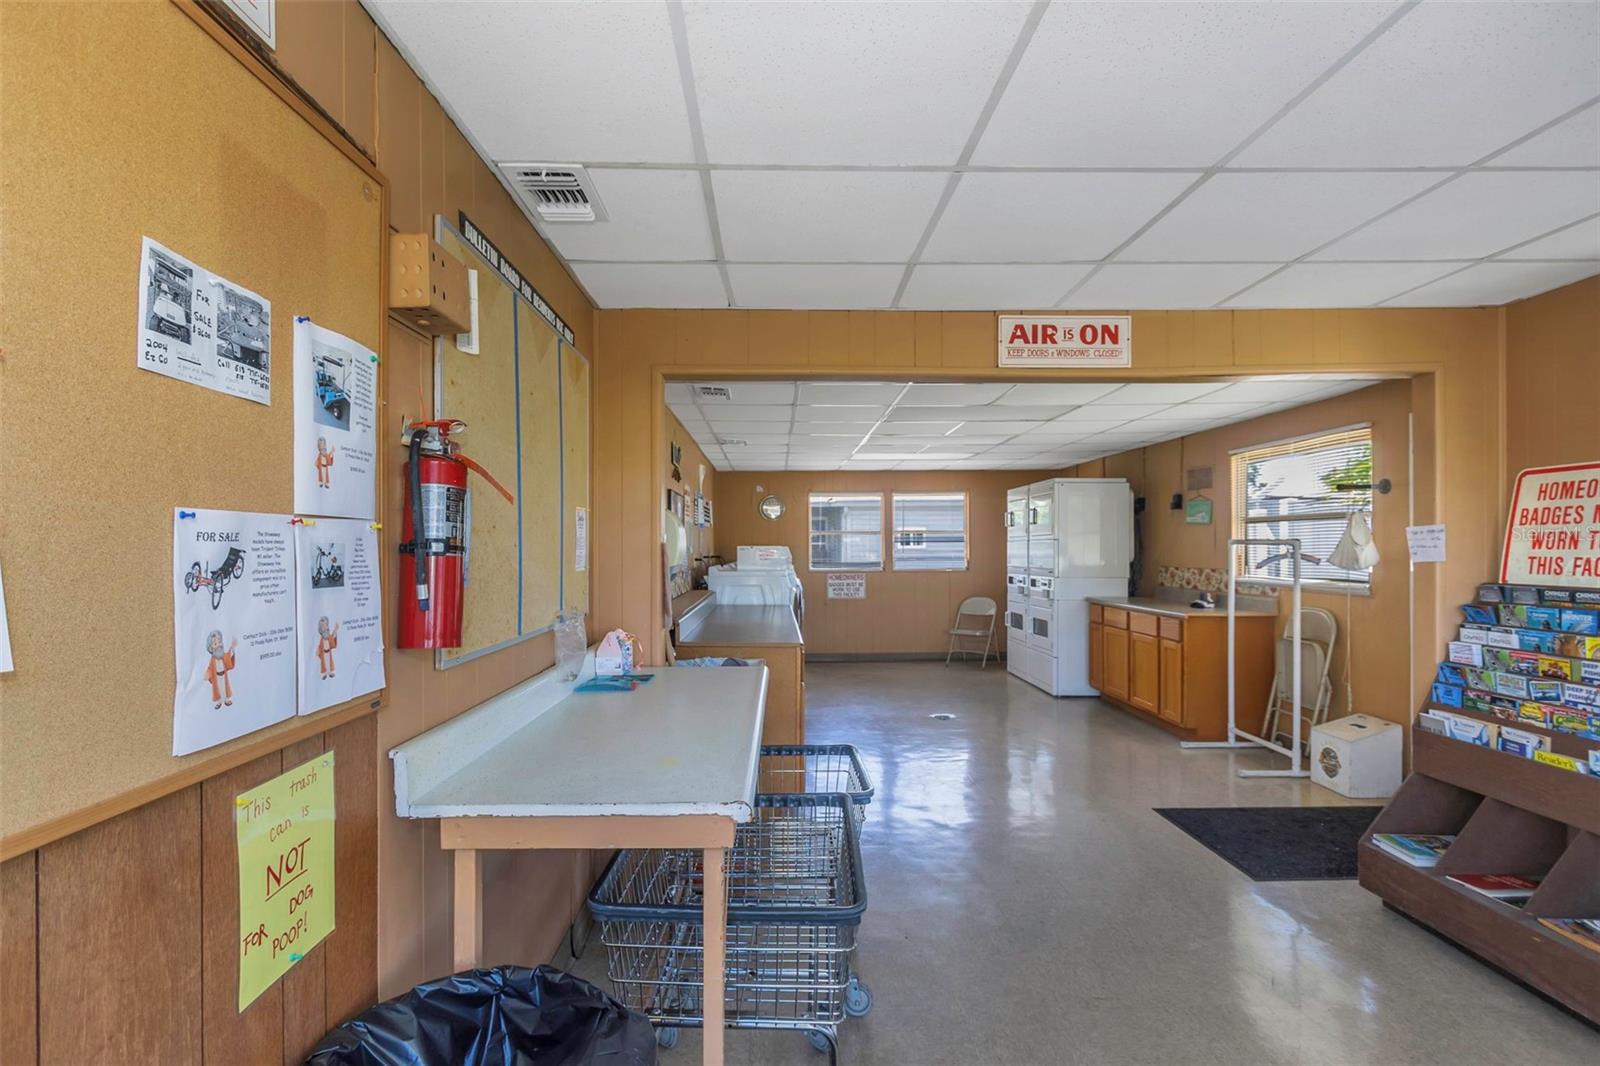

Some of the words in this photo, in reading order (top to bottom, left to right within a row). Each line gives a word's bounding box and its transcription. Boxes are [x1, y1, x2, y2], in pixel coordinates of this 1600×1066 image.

[464, 220, 499, 268] BULLETIN
[193, 311, 212, 328] SALE
[145, 338, 168, 352] 2004
[1008, 324, 1058, 345] AIR
[1063, 329, 1074, 340] IS
[1079, 323, 1119, 345] ON
[217, 358, 231, 369] Call
[1007, 348, 1024, 357] KEEP
[1027, 348, 1049, 357] DOORS
[1056, 348, 1090, 357] WINDOWS
[1537, 479, 1599, 501] HOMEO
[1519, 504, 1584, 526] BADGES
[196, 531, 216, 542] FOR
[218, 532, 240, 542] SALE
[1532, 531, 1579, 550] WORN
[1528, 556, 1564, 575] THIS
[242, 795, 272, 823] This
[288, 766, 317, 797] trash
[269, 818, 292, 843] can
[301, 805, 310, 819] is
[265, 837, 311, 897] NOT
[243, 923, 269, 956] FOR
[288, 884, 314, 916] DOG
[272, 911, 309, 960] POOP!
